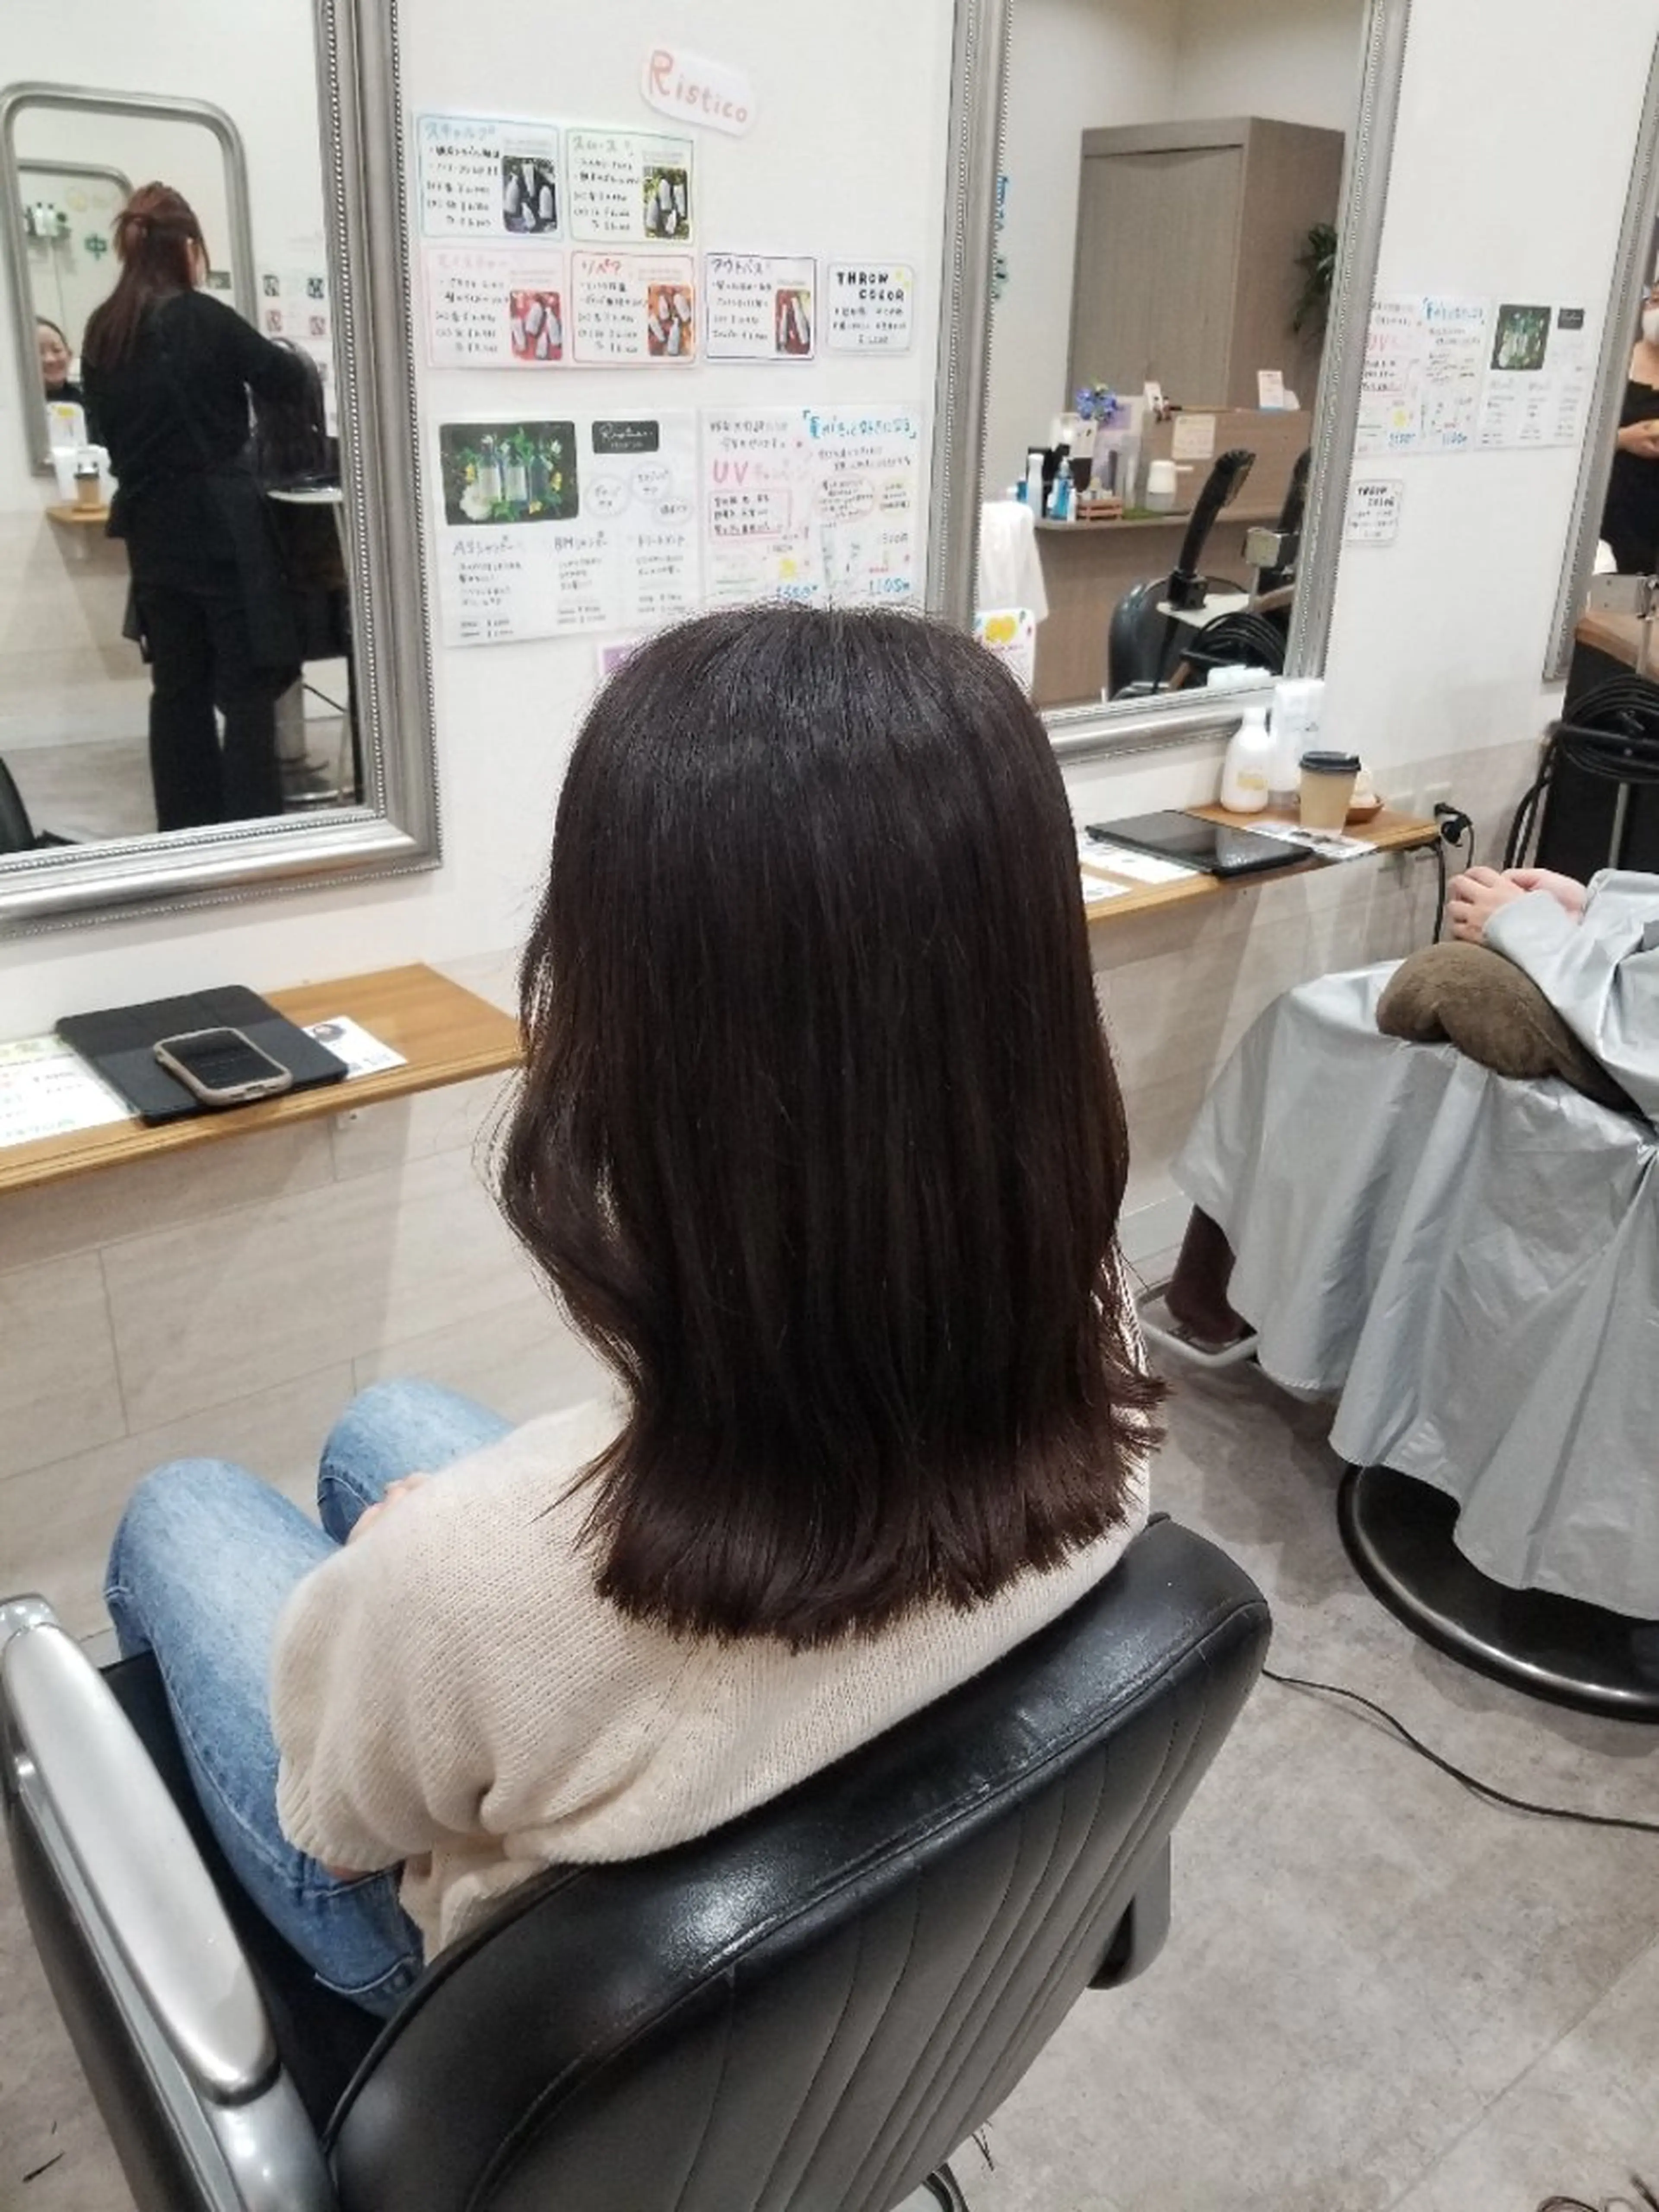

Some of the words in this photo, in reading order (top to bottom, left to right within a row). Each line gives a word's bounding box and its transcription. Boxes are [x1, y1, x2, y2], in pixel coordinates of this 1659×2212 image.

[648, 49, 748, 123] Ristico
[837, 271, 889, 286] THROW
[858, 288, 905, 302] COLOR
